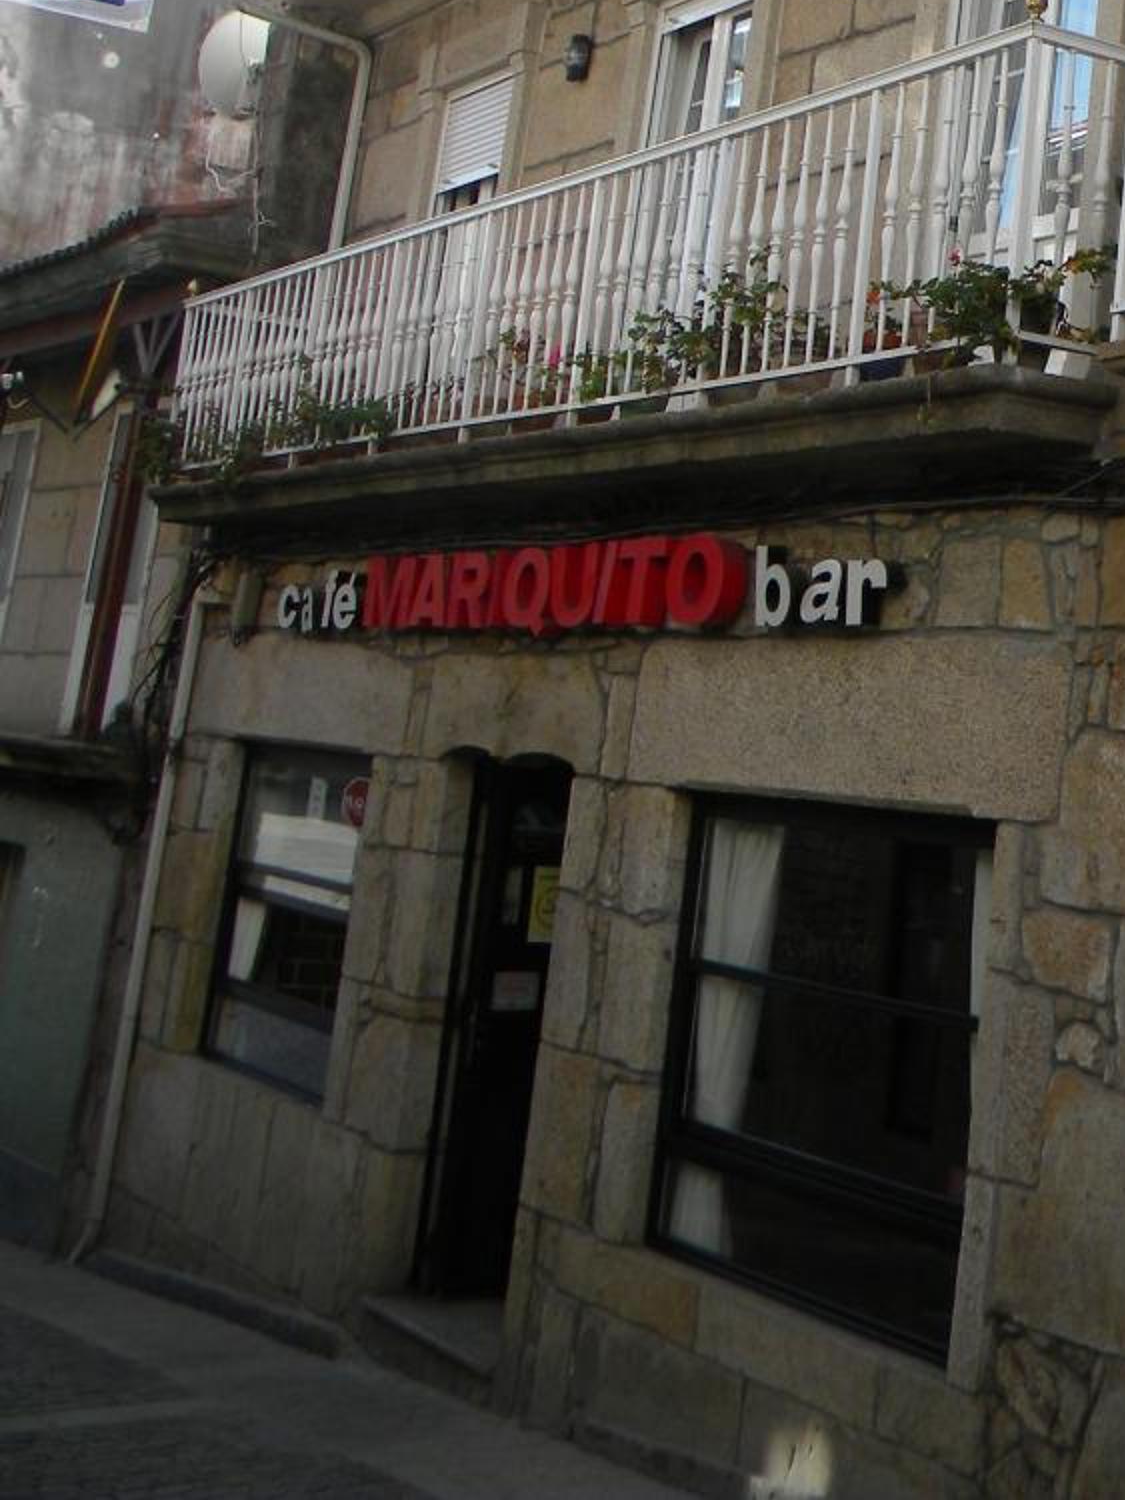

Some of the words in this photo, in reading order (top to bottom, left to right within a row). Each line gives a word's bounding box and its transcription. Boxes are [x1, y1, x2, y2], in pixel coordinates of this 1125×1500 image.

[277, 569, 359, 631] café
[362, 533, 736, 637] MARIQUITO
[755, 544, 888, 628] bar
